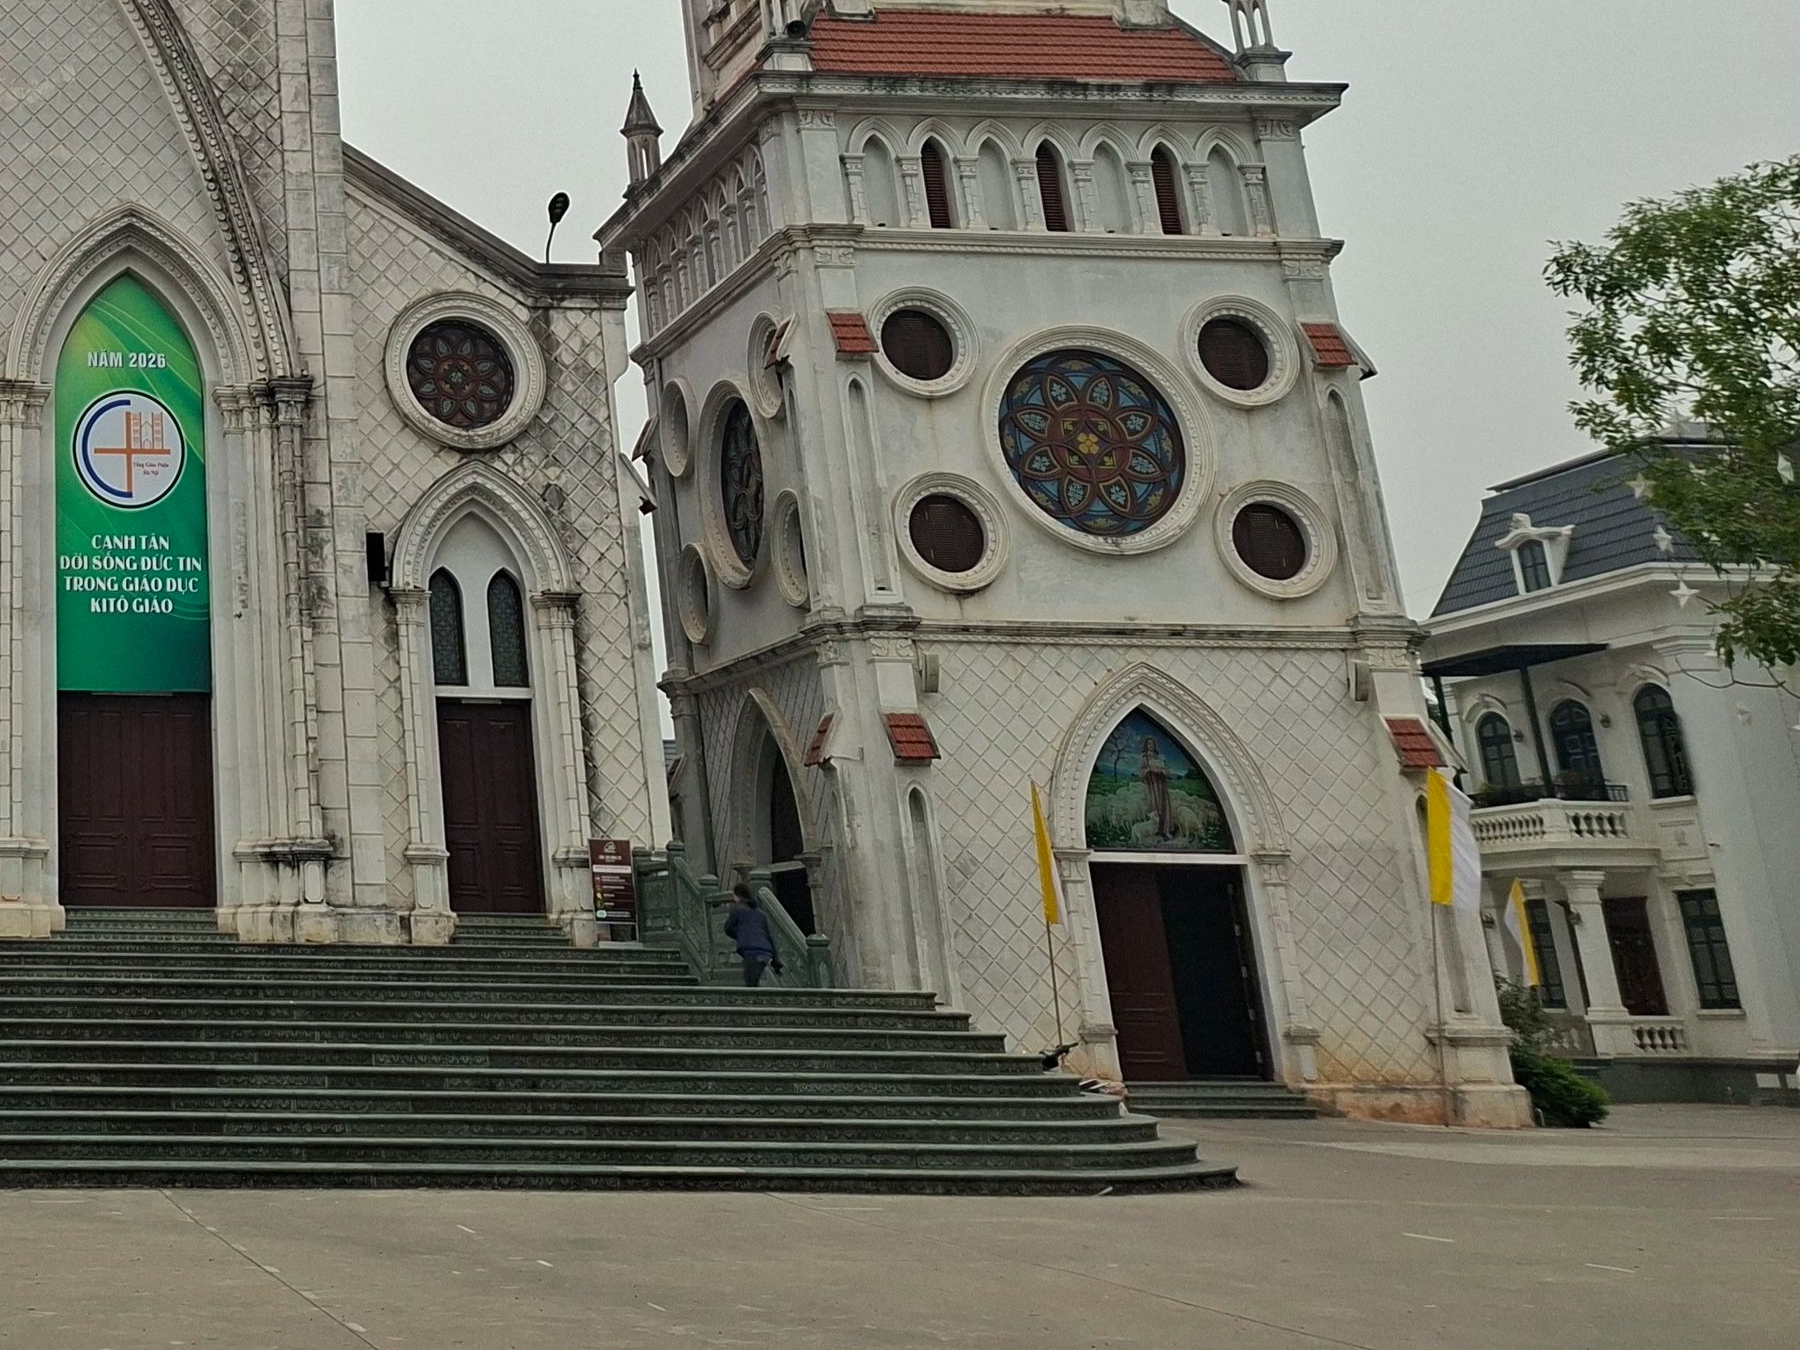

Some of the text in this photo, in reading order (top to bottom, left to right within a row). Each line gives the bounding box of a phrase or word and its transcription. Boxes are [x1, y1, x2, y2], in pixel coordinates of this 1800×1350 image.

[87, 348, 166, 368] NĂM 2026
[91, 532, 170, 550] CANH TÂN
[91, 550, 138, 571] SỐNG
[176, 556, 202, 572] TIN
[63, 573, 199, 595] TRONG GIÁO DỤC
[90, 594, 173, 614] KITÔ GIÁO
